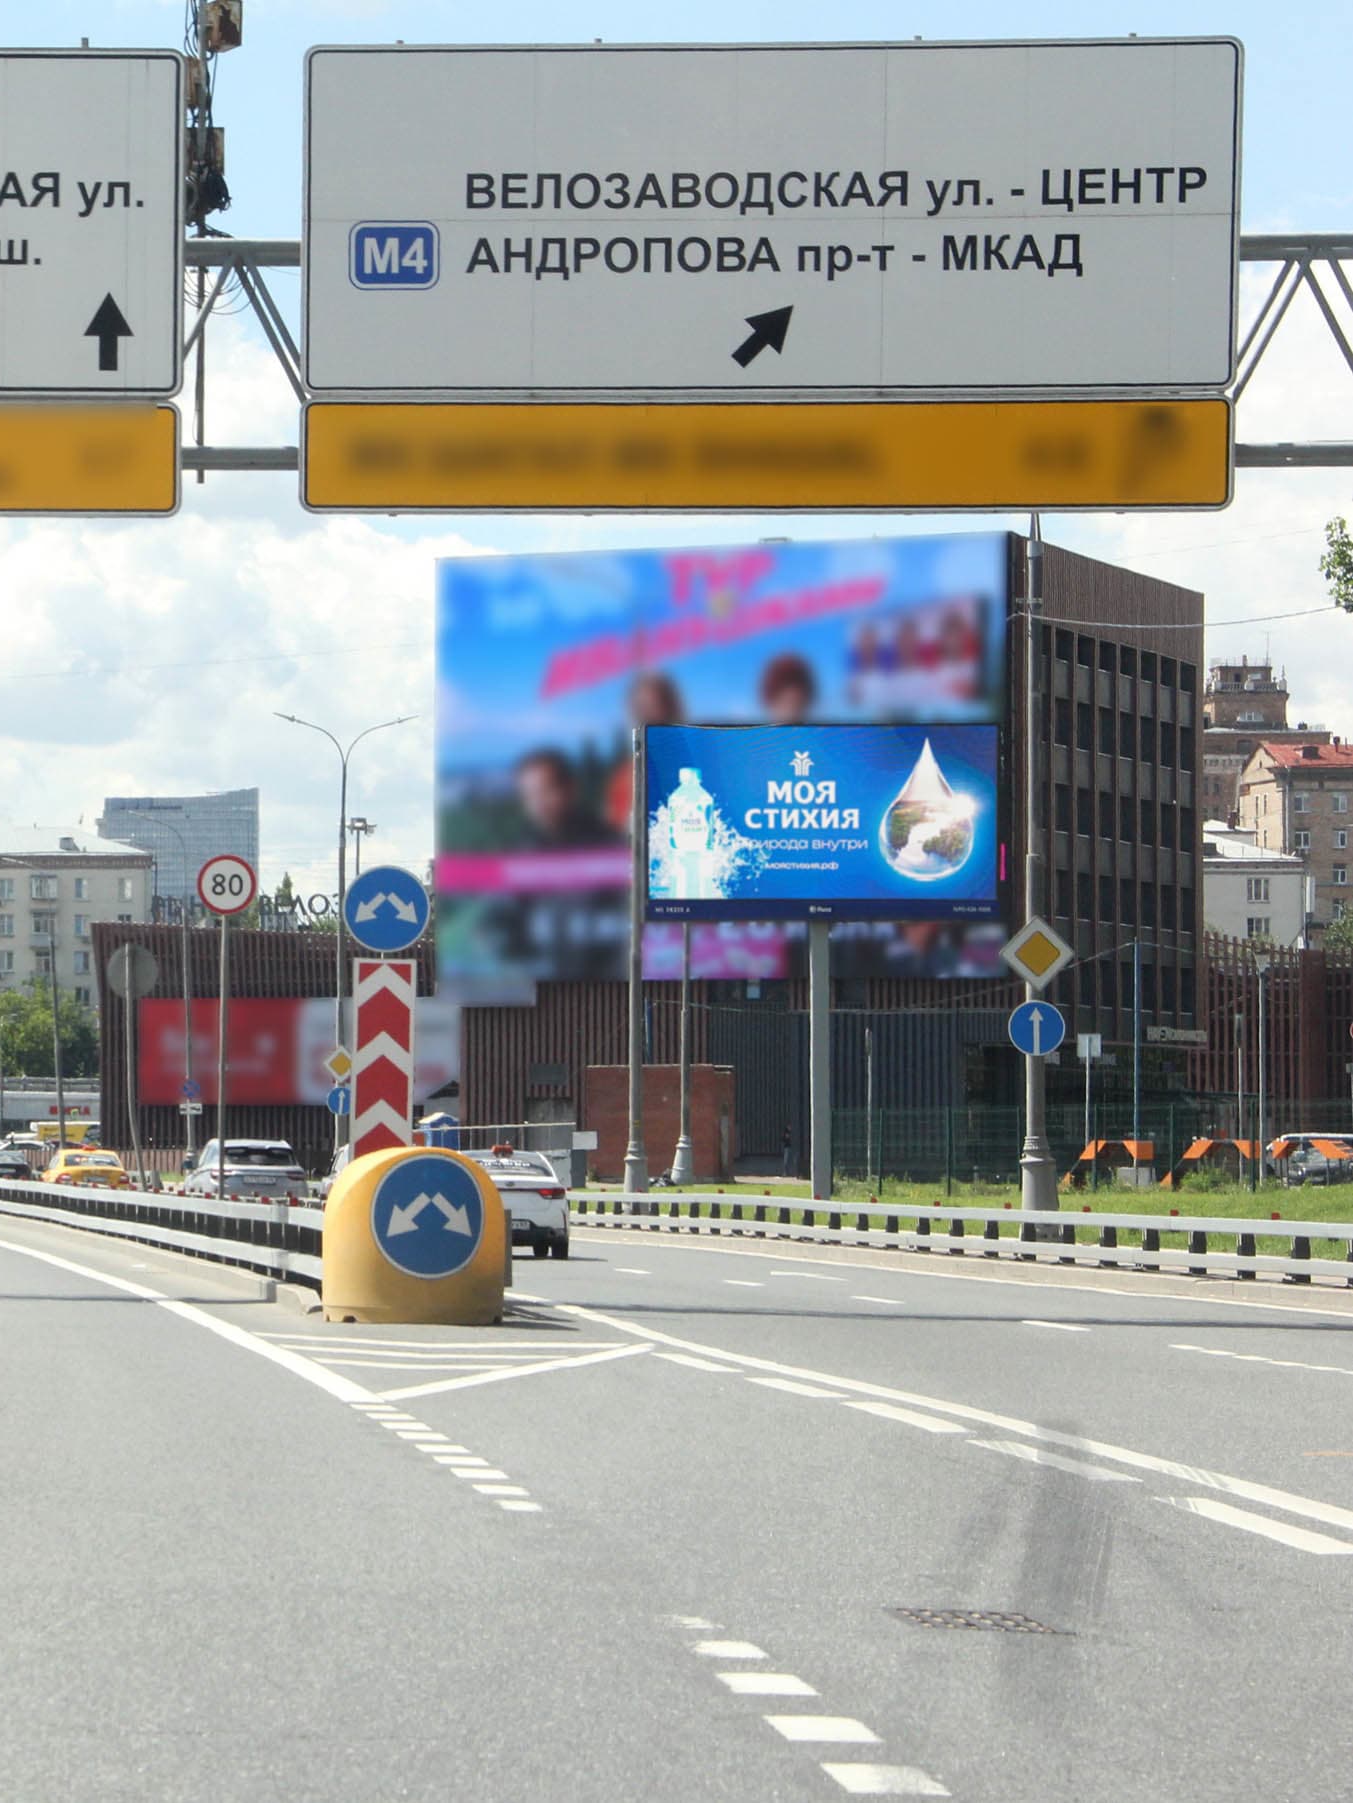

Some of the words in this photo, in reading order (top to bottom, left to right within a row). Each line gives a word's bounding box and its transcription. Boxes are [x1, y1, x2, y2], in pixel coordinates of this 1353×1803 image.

[77, 180, 146, 218] ул.
[465, 170, 910, 217] ВЕЛОЗАВОДСКАЯ
[925, 178, 995, 217] ул.
[1041, 166, 1208, 213] ЦЕНТР
[465, 236, 782, 281] АНДРОПОВА
[796, 243, 896, 282] пр-т
[941, 233, 1084, 278] МКАД
[767, 780, 837, 804] МОЯ
[744, 808, 860, 830] СТИХИЯ
[811, 838, 868, 851] внутри
[211, 873, 244, 897] 80
